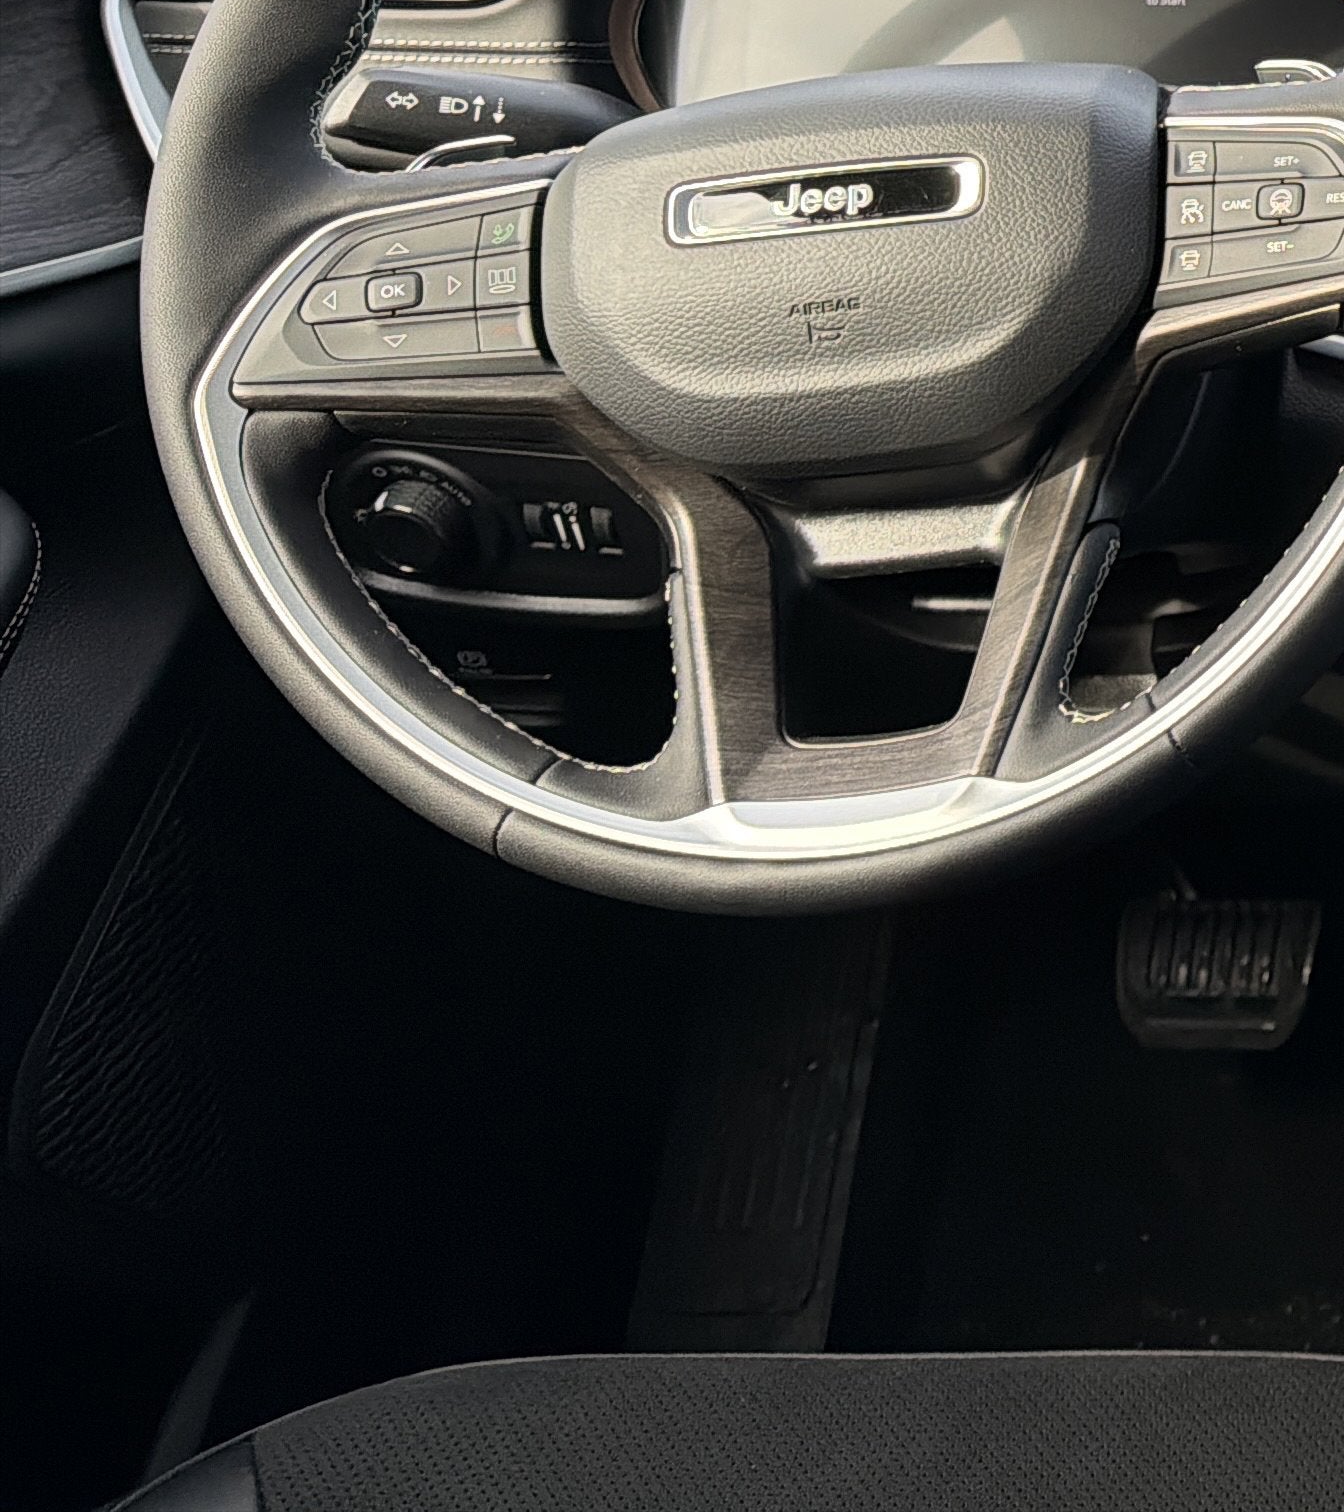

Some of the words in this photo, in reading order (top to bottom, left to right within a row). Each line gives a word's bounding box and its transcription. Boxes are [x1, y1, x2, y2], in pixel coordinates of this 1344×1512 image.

[1273, 156, 1300, 168] SET+
[769, 182, 874, 217] Jeep
[1221, 198, 1252, 212] CANC
[380, 283, 407, 299] OK
